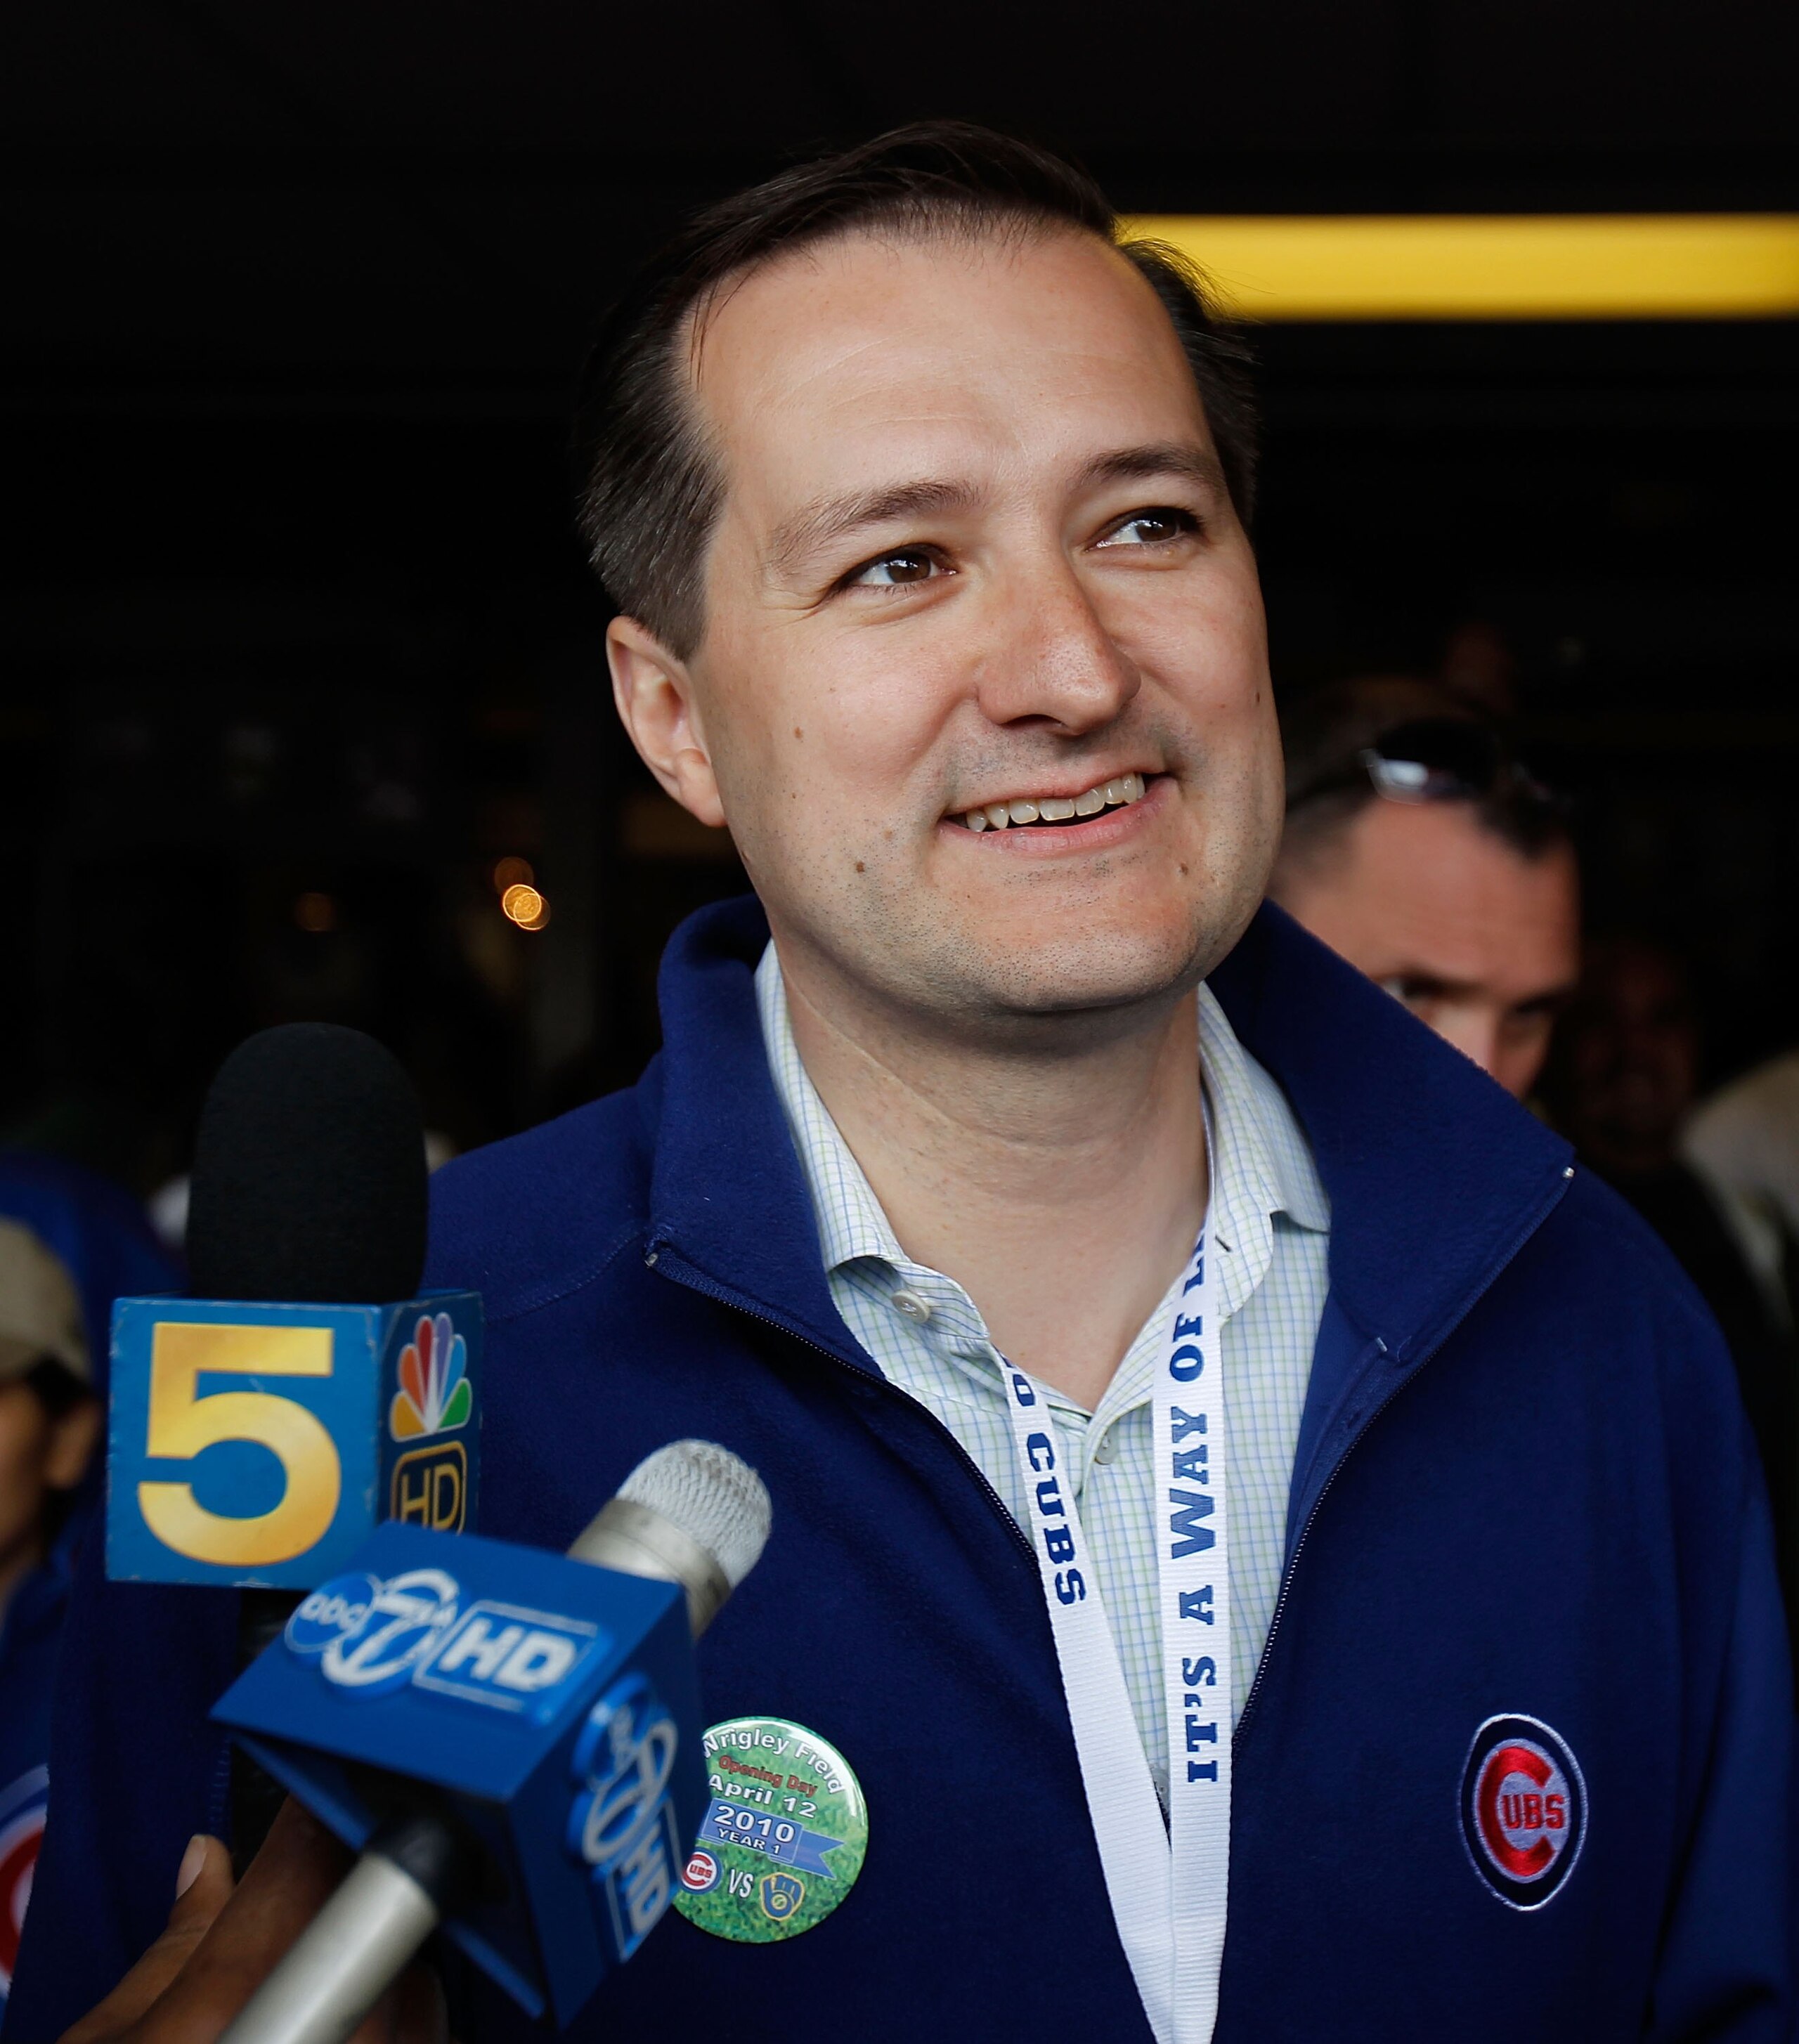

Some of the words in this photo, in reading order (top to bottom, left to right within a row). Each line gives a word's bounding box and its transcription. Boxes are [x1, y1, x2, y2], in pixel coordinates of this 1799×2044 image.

[1183, 1233, 1205, 1298] L
[1169, 1312, 1204, 1382] OF
[138, 1321, 341, 1567] 5
[401, 1464, 460, 1530] HD
[1169, 1406, 1216, 1560] WAY
[1027, 1432, 1087, 1606] CUBS
[1178, 1584, 1214, 1625] A
[440, 1619, 577, 1691] HD
[1182, 1655, 1219, 1783] IT'S
[708, 1773, 773, 1806] April
[784, 1796, 819, 1819] 12
[718, 1755, 784, 1789] Opening
[786, 1774, 819, 1797] Day
[795, 1741, 846, 1795] Field
[713, 1805, 796, 1844] 2010
[717, 1828, 766, 1851] YEAR
[772, 1844, 781, 1855] 1
[728, 1868, 755, 1899] VS
